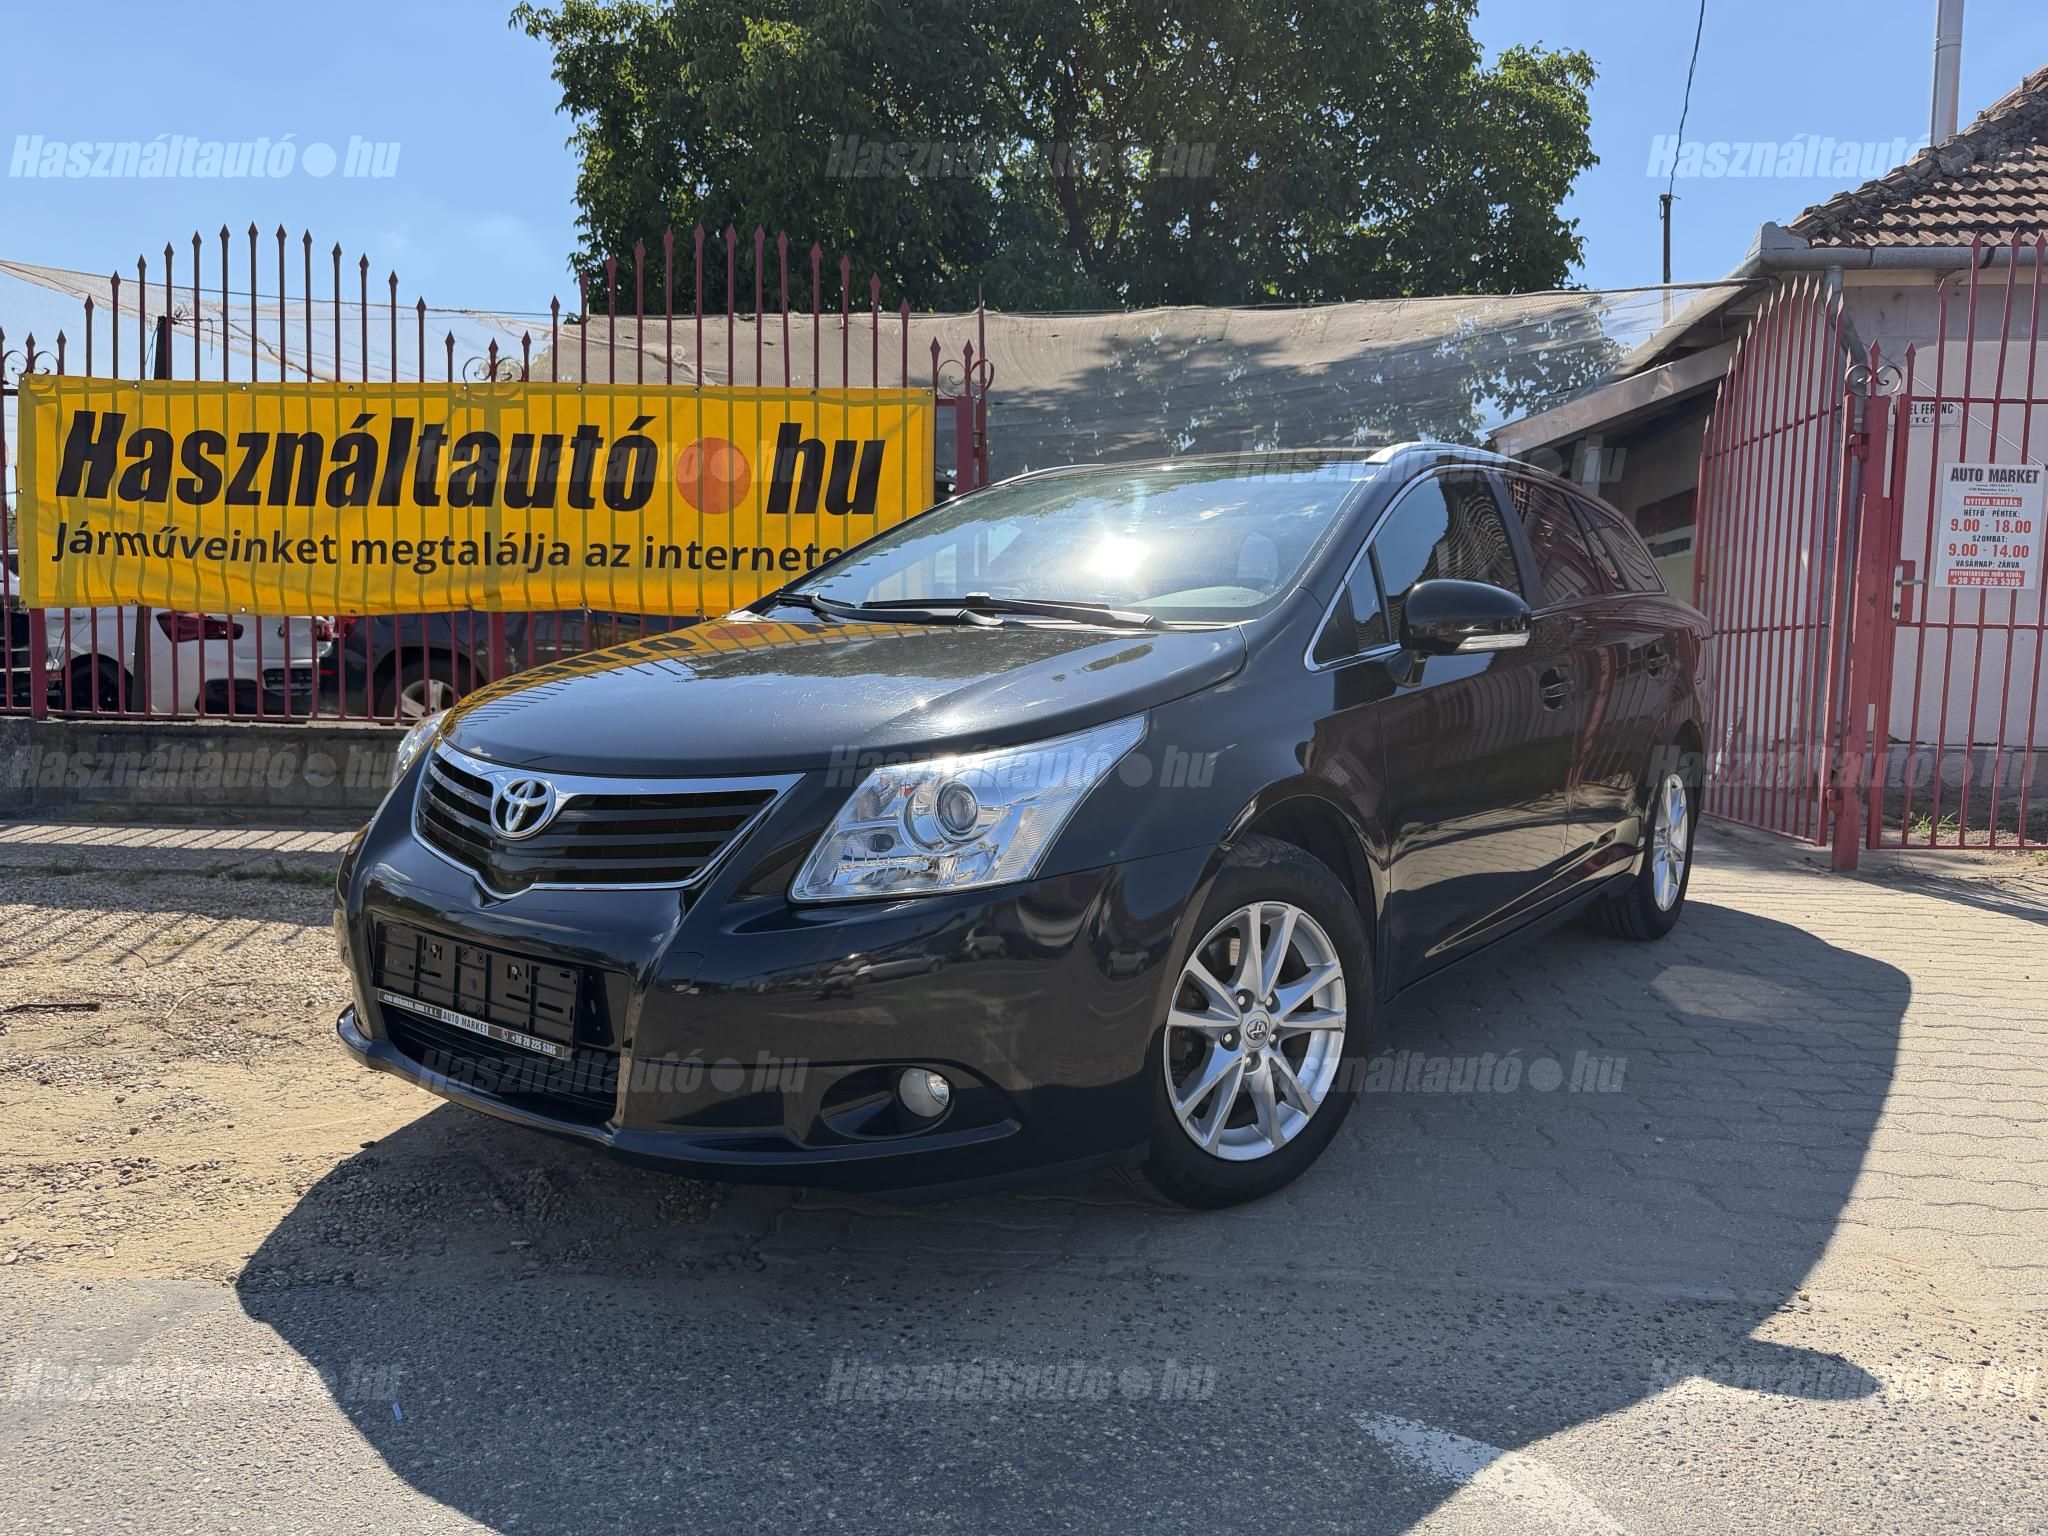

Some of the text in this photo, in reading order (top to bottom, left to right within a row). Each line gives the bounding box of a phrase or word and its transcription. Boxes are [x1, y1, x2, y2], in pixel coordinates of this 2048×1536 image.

[58, 410, 659, 513] Használtautó
[1950, 467, 2040, 484] AUTO MARKET
[1950, 518, 1980, 532] 9.00
[1994, 520, 2032, 534] 18.00
[52, 522, 336, 565] Járműveinket
[352, 532, 571, 575] megtalálja
[585, 544, 630, 568] az
[1948, 543, 1978, 557] 9.00
[1992, 544, 2030, 558] 14.00
[442, 1009, 460, 1027] AUTO
[461, 1013, 488, 1035] MARKET
